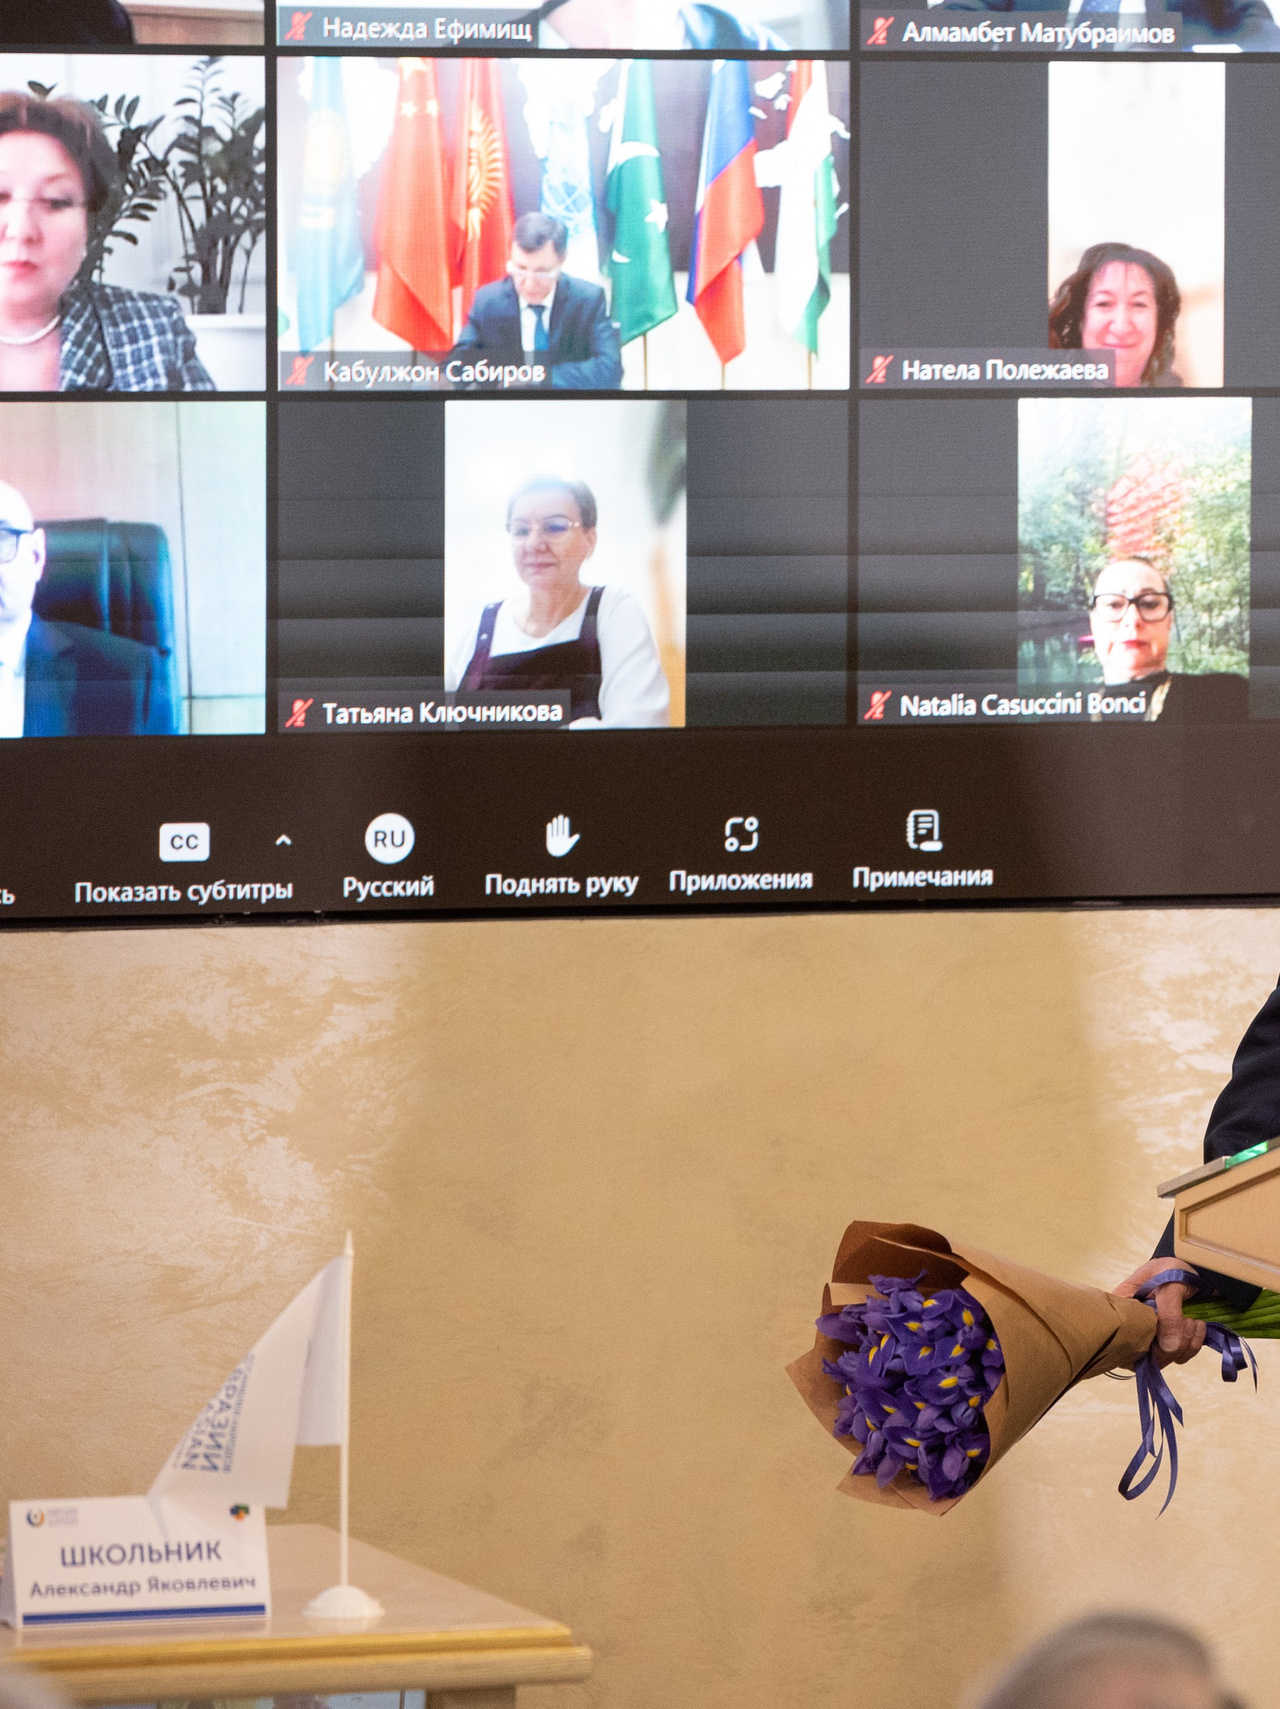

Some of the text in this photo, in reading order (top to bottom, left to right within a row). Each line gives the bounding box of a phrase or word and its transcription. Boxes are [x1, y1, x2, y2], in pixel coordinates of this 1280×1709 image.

[323, 16, 532, 44] Надежда Ефимищ
[903, 22, 1175, 49] Алмамбет Матубраимов
[325, 360, 545, 387] Кабулжон Сабиров
[903, 360, 1108, 381] Натела Полежаева
[323, 701, 563, 725] Татьяна Ключникова
[900, 692, 1147, 717] Natalia Casuccini Bonci
[170, 834, 199, 850] CC
[373, 830, 405, 848] RU
[343, 875, 434, 901] Русский
[485, 874, 639, 898] Поднять руку
[670, 870, 814, 894] Приложения
[853, 866, 994, 889] Примечания
[75, 879, 293, 905] Показать субтитры
[60, 1540, 222, 1567] ШКОЛЬНИК
[30, 1575, 256, 1600] Александр Яковлевич
